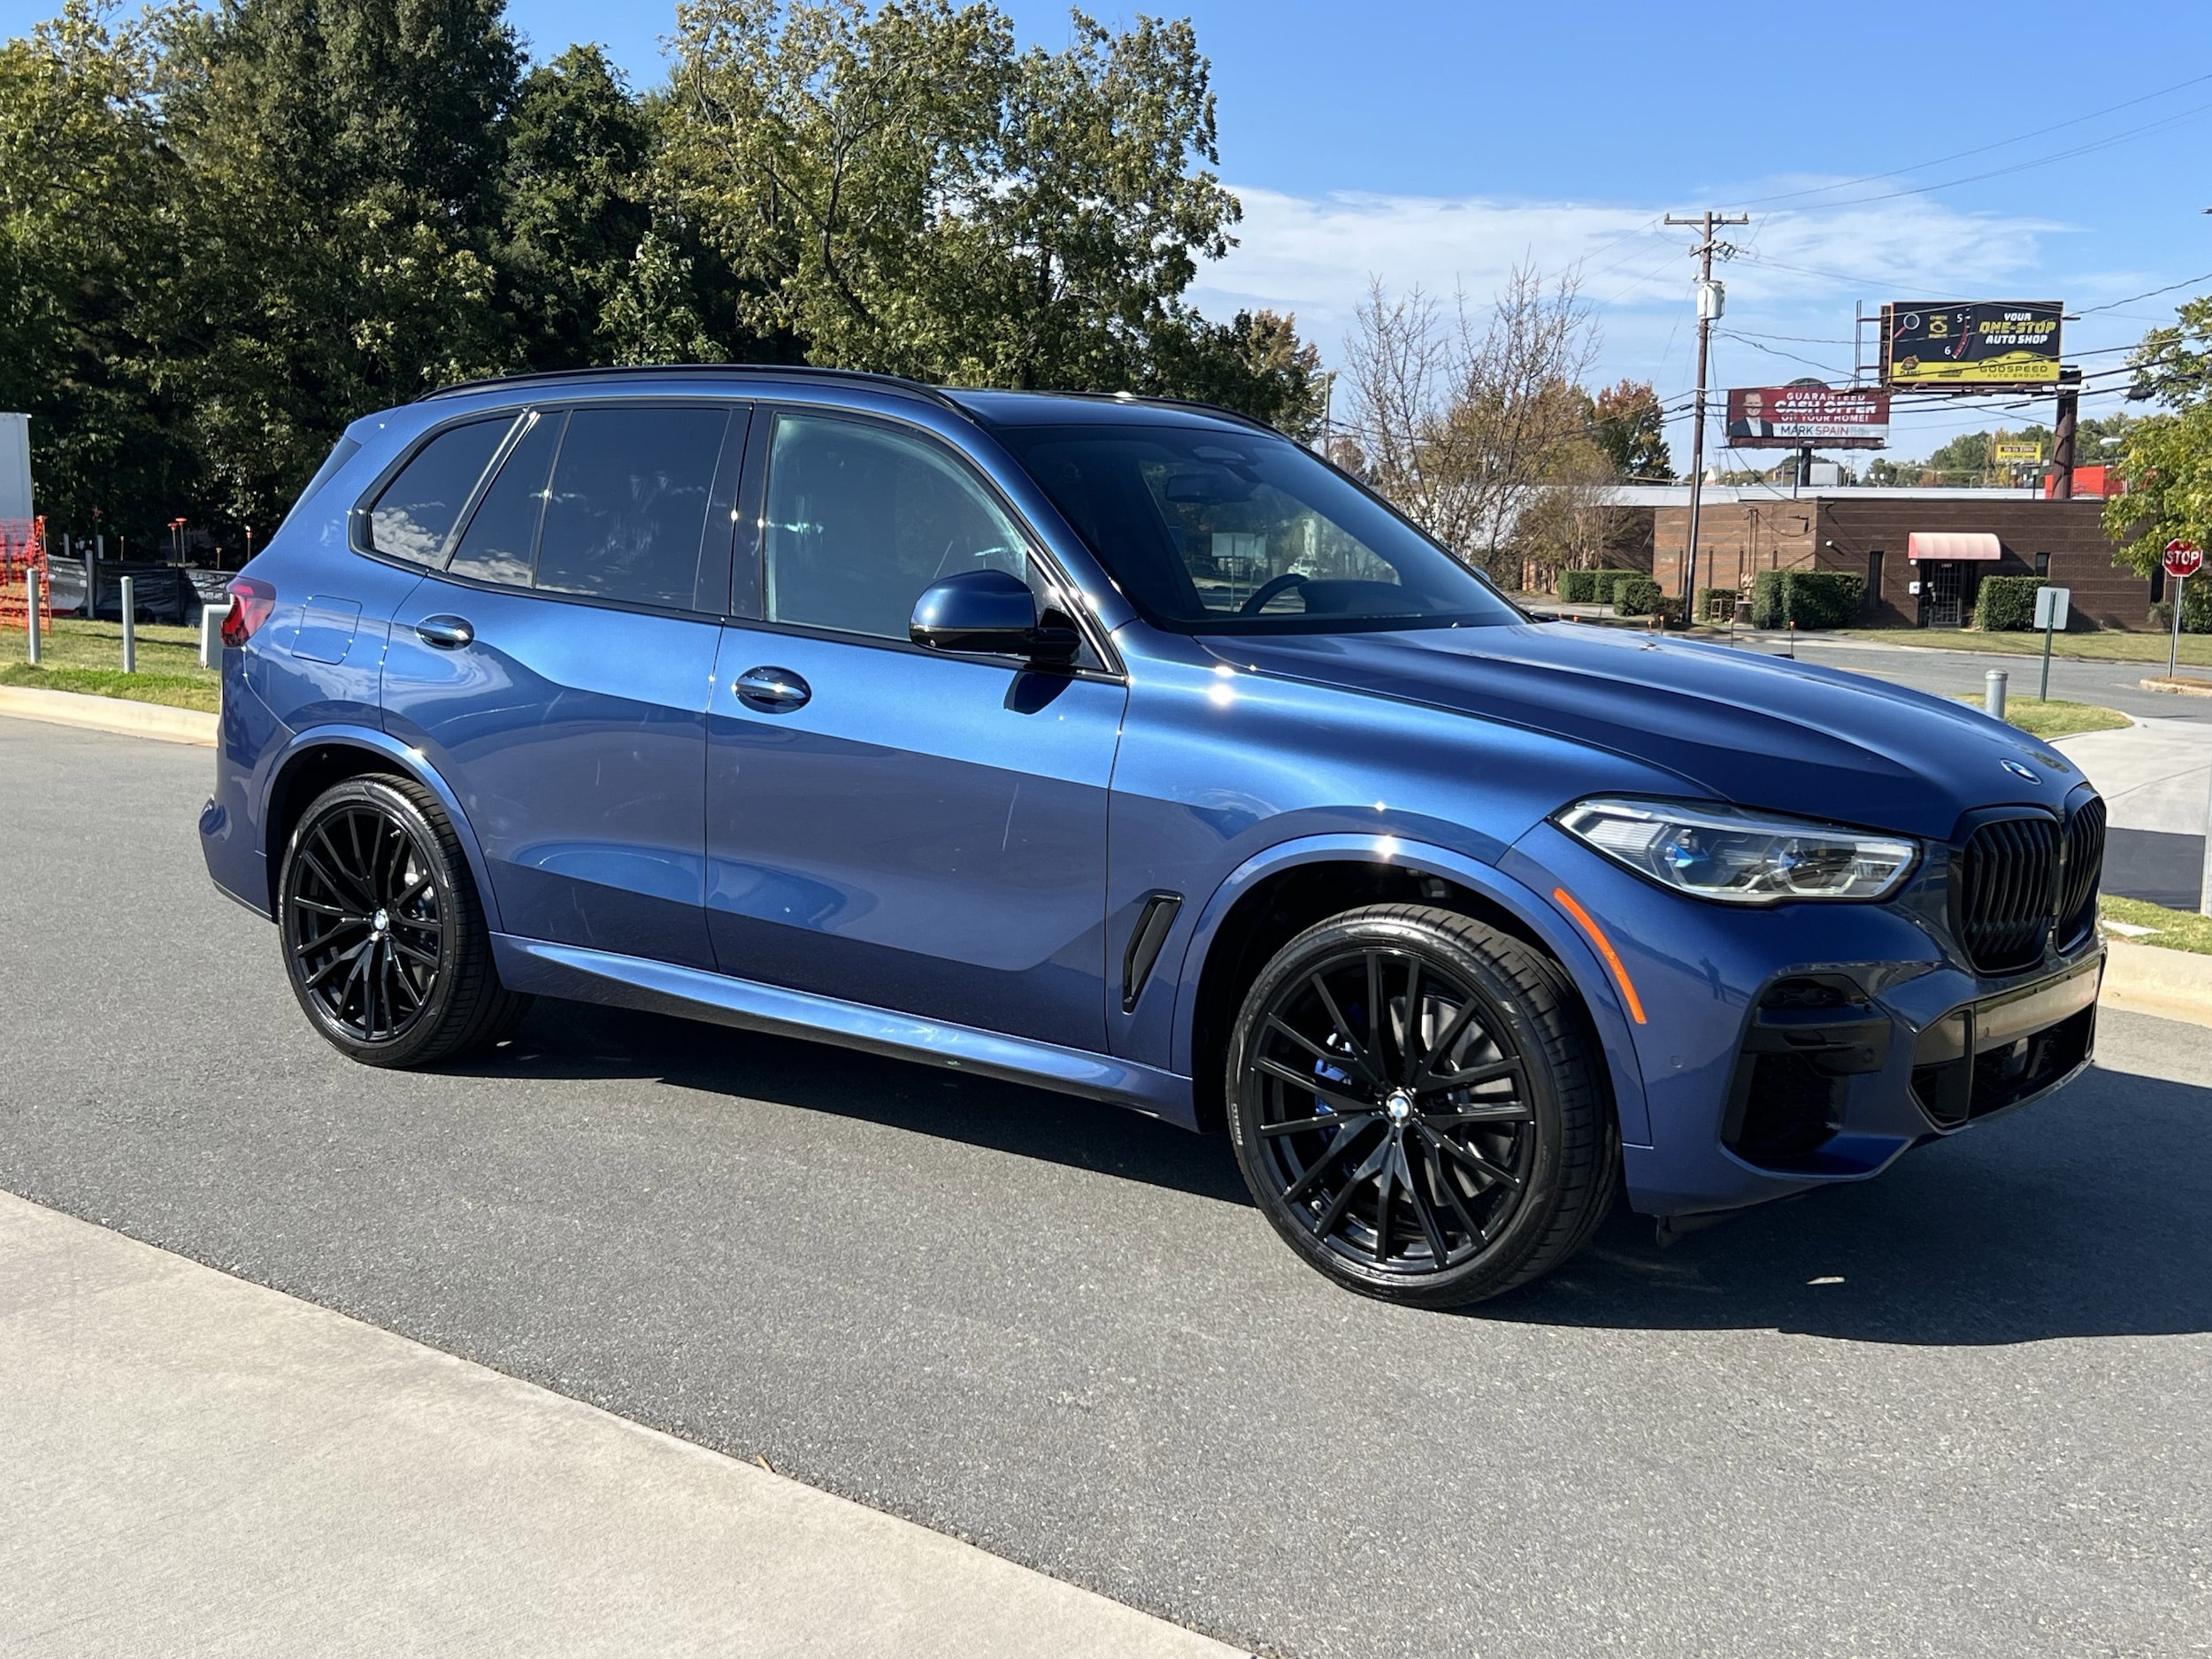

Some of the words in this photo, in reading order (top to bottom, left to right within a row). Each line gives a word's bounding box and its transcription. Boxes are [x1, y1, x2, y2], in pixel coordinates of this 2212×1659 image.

[1956, 313, 1963, 323] 5
[2004, 312, 2032, 321] YOUR
[1979, 321, 2056, 334] ONE-STOP
[1985, 334, 2016, 344] AUTO
[2017, 334, 2048, 344] SHOP
[1944, 346, 1951, 355] 6
[1774, 400, 1820, 413] CASH
[1824, 401, 1877, 414] OFFER
[1780, 426, 1814, 435] MARK
[1816, 426, 1849, 435] SPAIN
[2165, 549, 2200, 565] STOP
